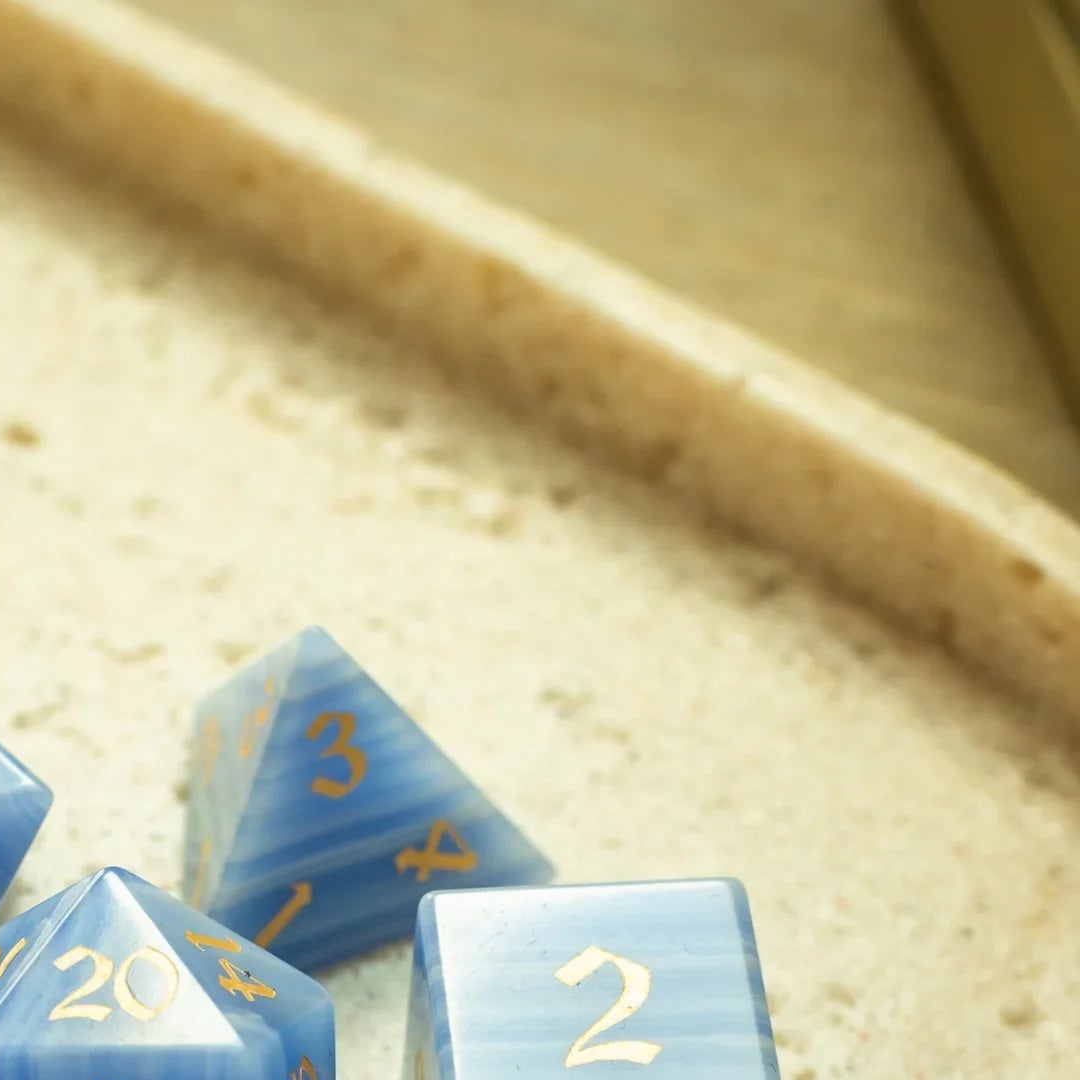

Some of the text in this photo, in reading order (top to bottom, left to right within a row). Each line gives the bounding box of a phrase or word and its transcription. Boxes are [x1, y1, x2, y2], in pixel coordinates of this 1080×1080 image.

[305, 711, 368, 799] 3
[394, 819, 479, 882] 4
[48, 945, 180, 1021] 20
[184, 930, 277, 1002] 14
[554, 944, 663, 1069] 2
